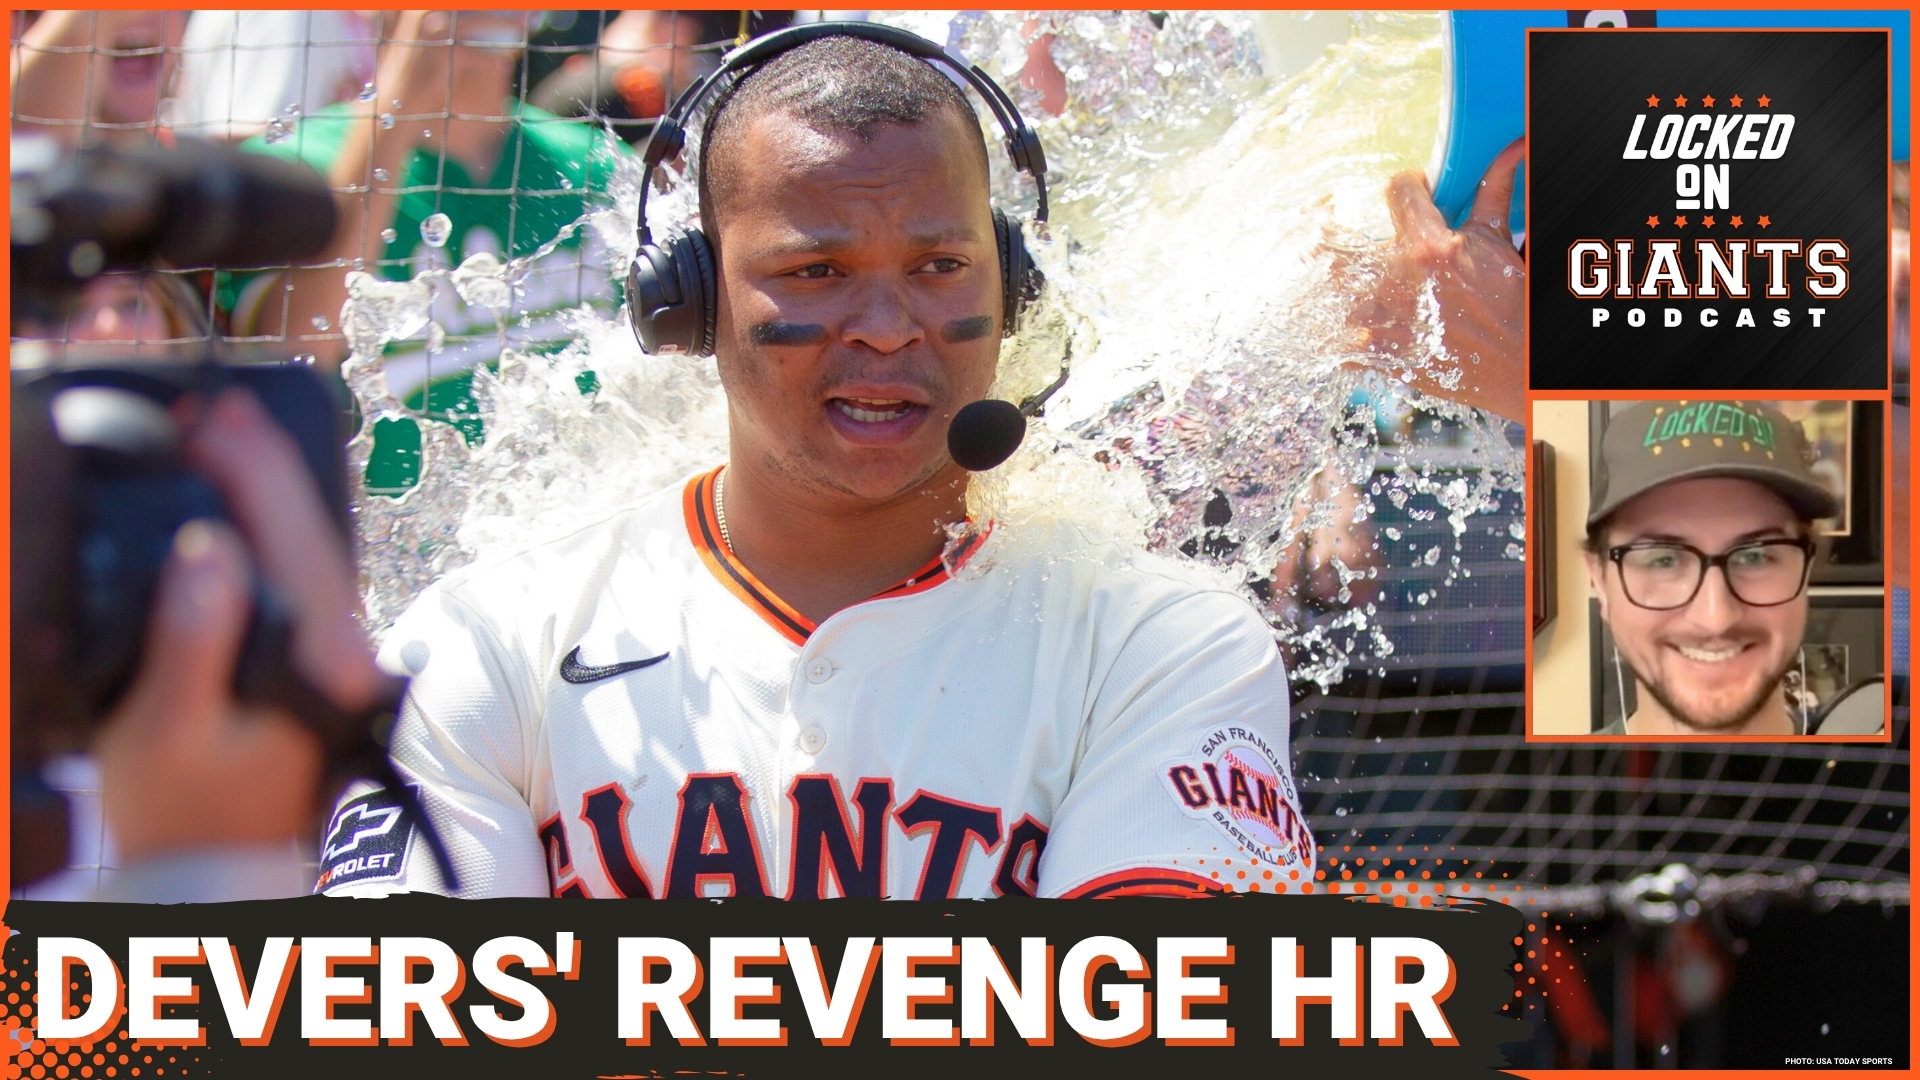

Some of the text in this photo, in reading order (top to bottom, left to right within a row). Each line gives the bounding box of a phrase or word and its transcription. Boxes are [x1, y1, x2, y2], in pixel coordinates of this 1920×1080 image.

[1643, 402, 1745, 447] LOCKED
[1202, 727, 1294, 800] SAN FRANCISCO
[1167, 762, 1312, 869] GIANTS
[1213, 811, 1278, 866] BASEBALL
